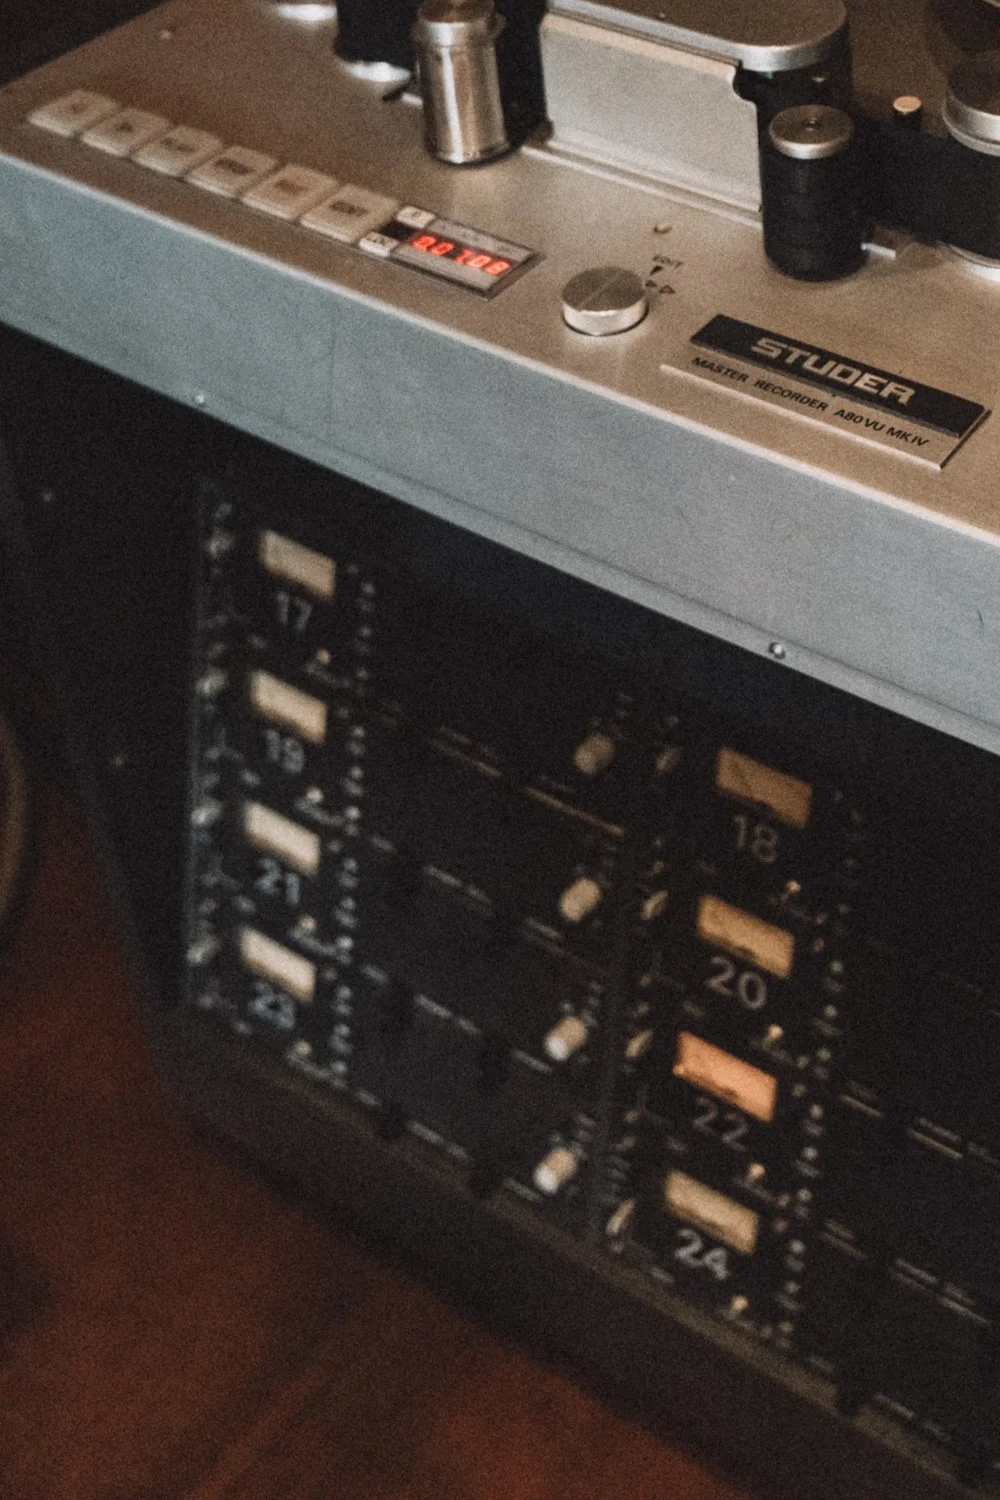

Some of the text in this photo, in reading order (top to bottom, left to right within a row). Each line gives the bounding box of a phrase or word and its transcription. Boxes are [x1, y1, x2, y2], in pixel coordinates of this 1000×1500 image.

[691, 357, 749, 384] MASTER
[753, 379, 829, 412] RECORDER
[751, 337, 917, 406] STUDER
[276, 591, 313, 630] 17
[733, 813, 779, 864] 18
[704, 957, 768, 1010] 20
[693, 1096, 749, 1148] 22
[674, 1227, 730, 1281] 24
